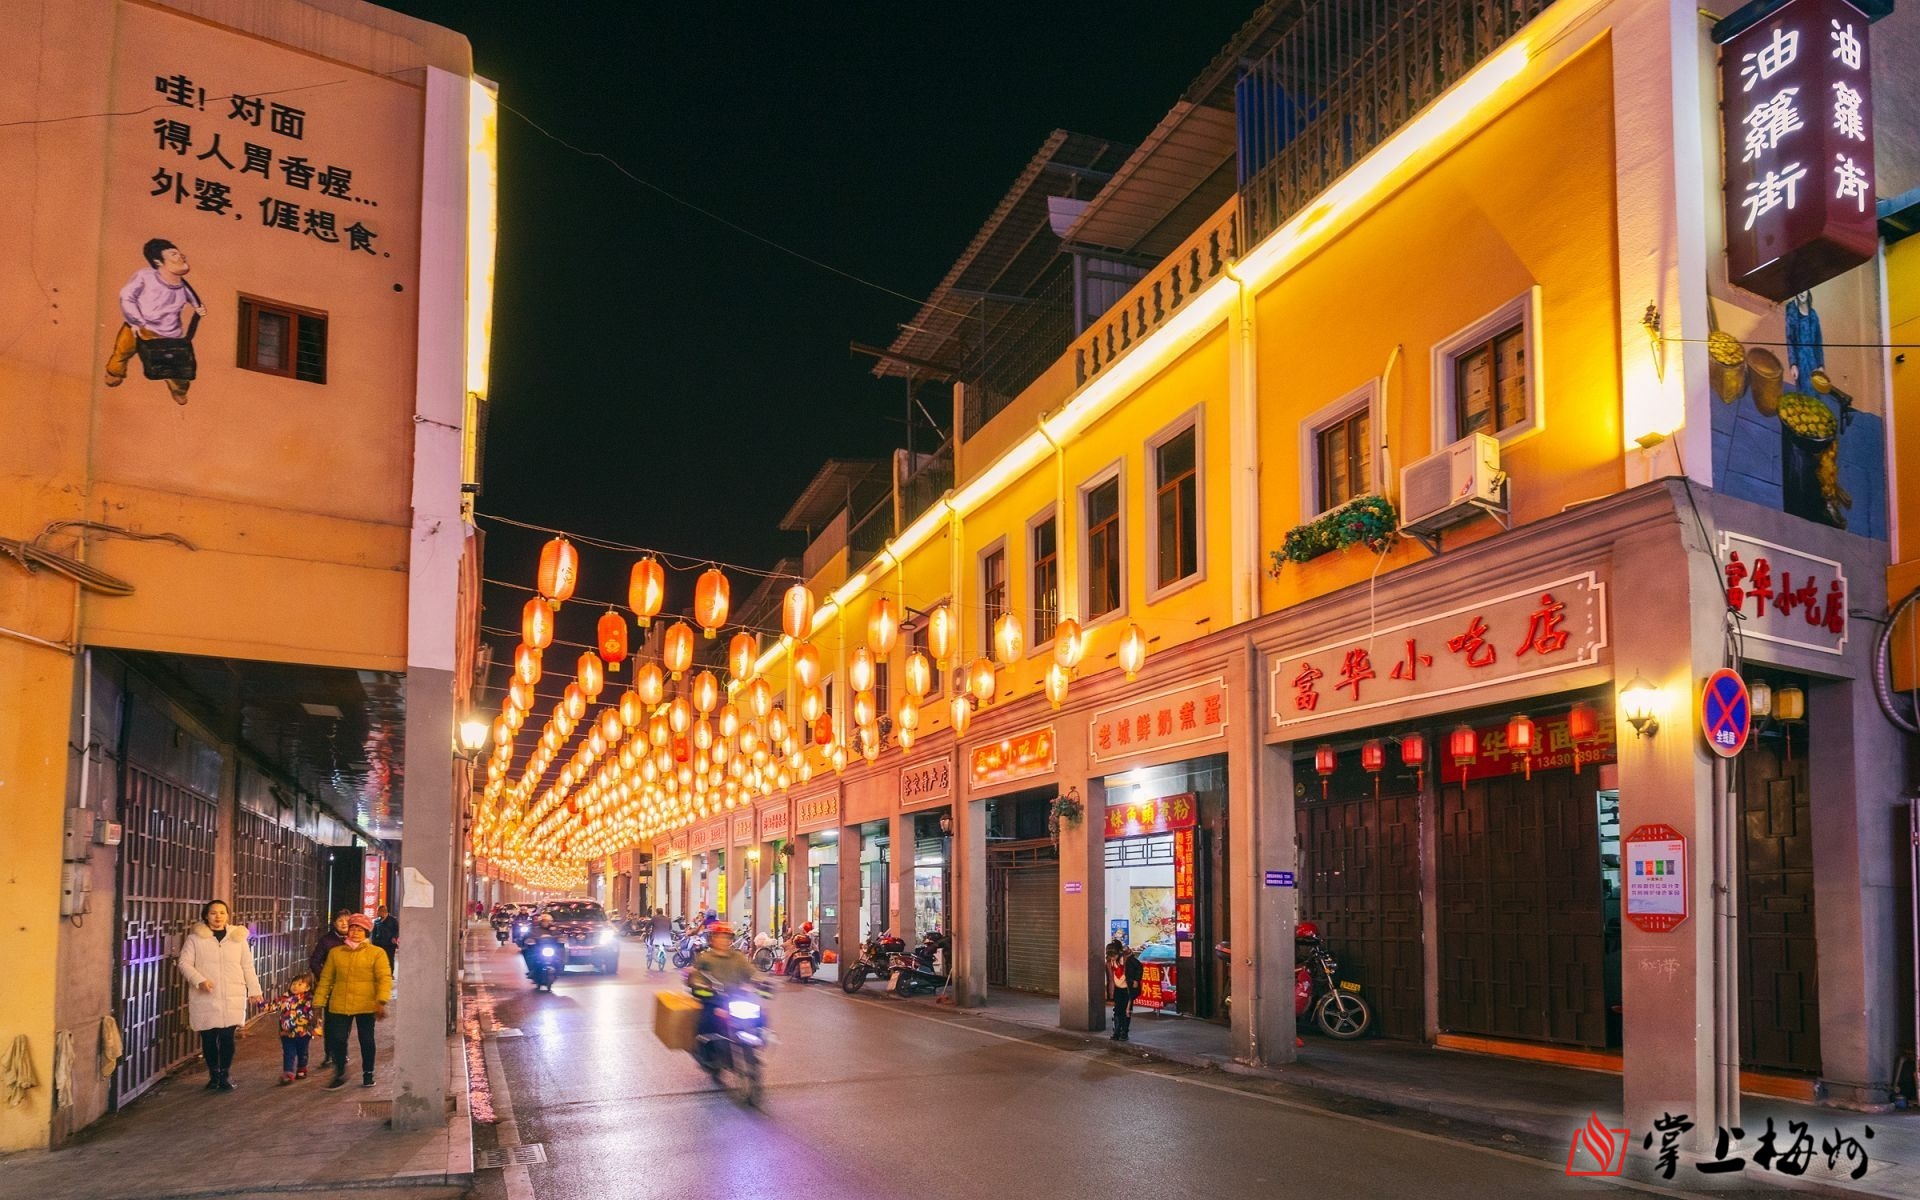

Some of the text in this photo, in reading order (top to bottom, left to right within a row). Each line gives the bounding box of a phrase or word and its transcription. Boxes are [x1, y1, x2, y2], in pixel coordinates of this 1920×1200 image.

[1725, 551, 1844, 634] 富华小吃店
[1291, 593, 1571, 711] 富华小吃店
